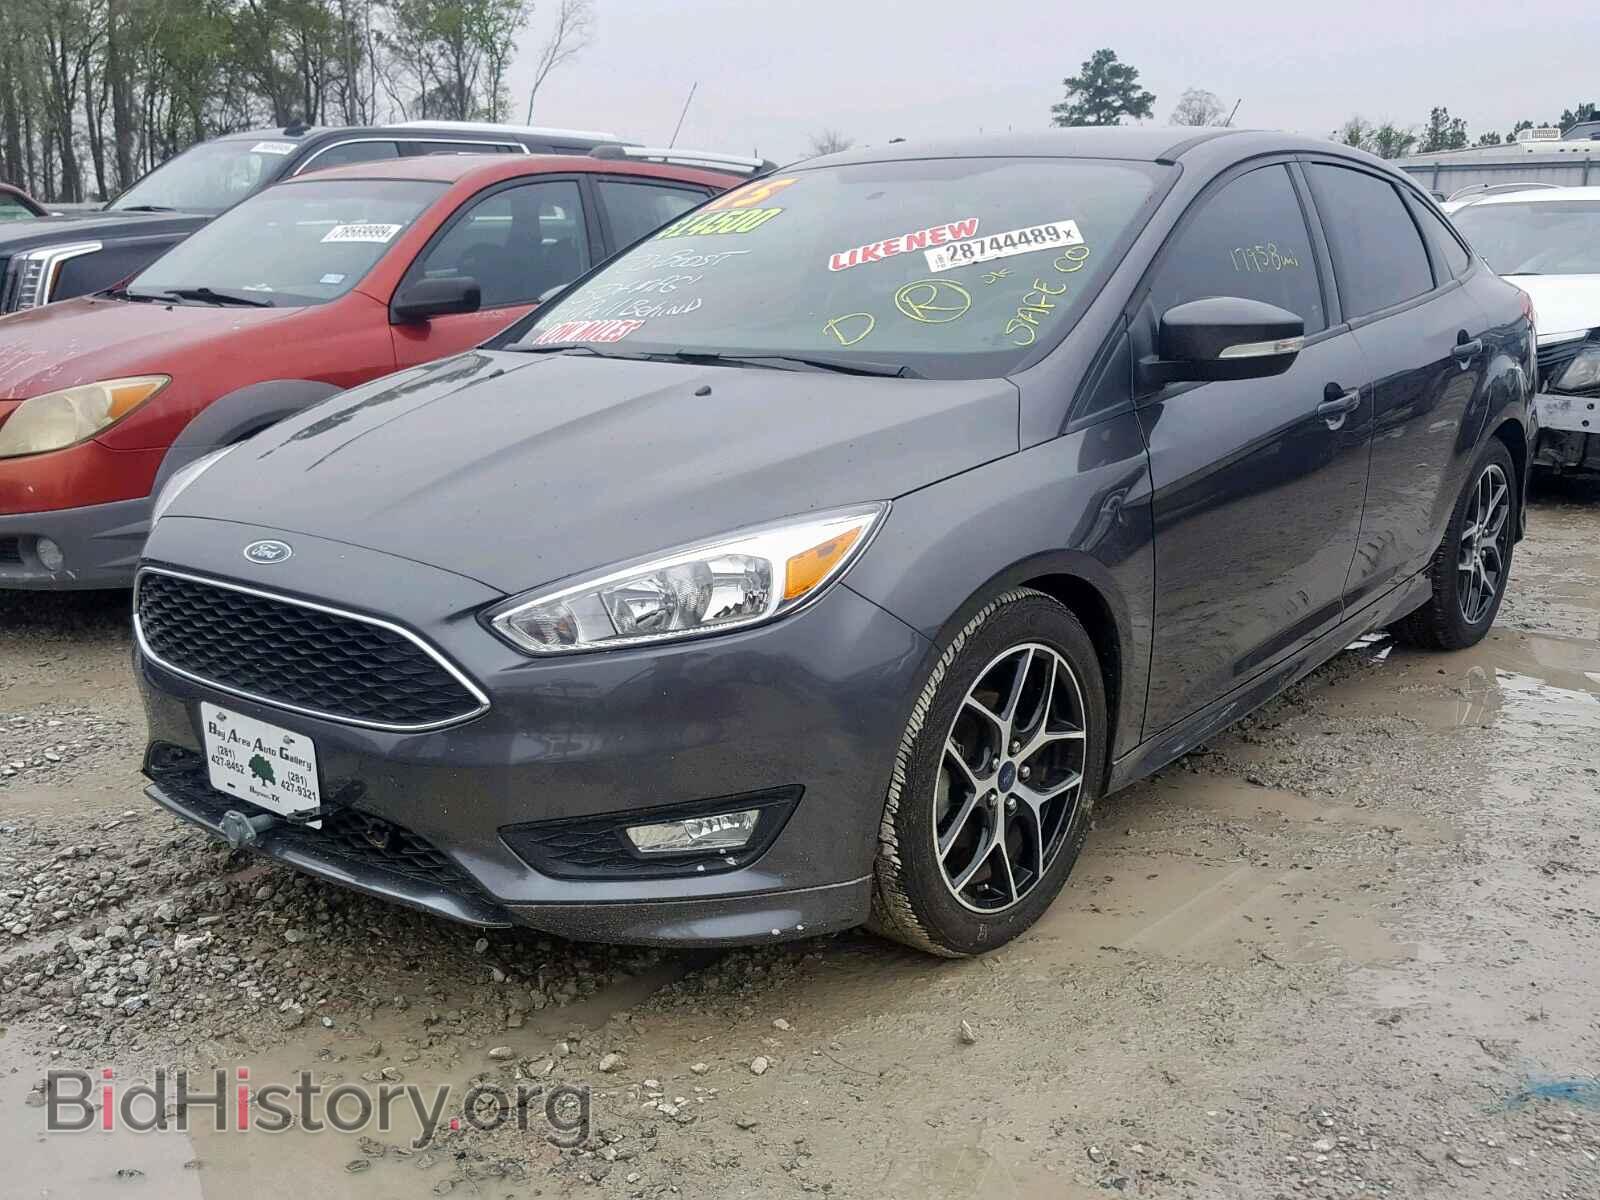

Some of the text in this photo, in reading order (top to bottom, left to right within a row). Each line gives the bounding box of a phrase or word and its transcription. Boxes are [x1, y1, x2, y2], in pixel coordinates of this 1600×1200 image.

[831, 237, 901, 270] LIKE
[905, 220, 977, 251] NEW
[945, 225, 1062, 262] 28744489
[822, 311, 876, 346] D
[207, 720, 312, 772] Bay Area Auto Gallery
[217, 745, 235, 760] (281)
[280, 779, 317, 801] 427-9321
[287, 771, 308, 788] (281)
